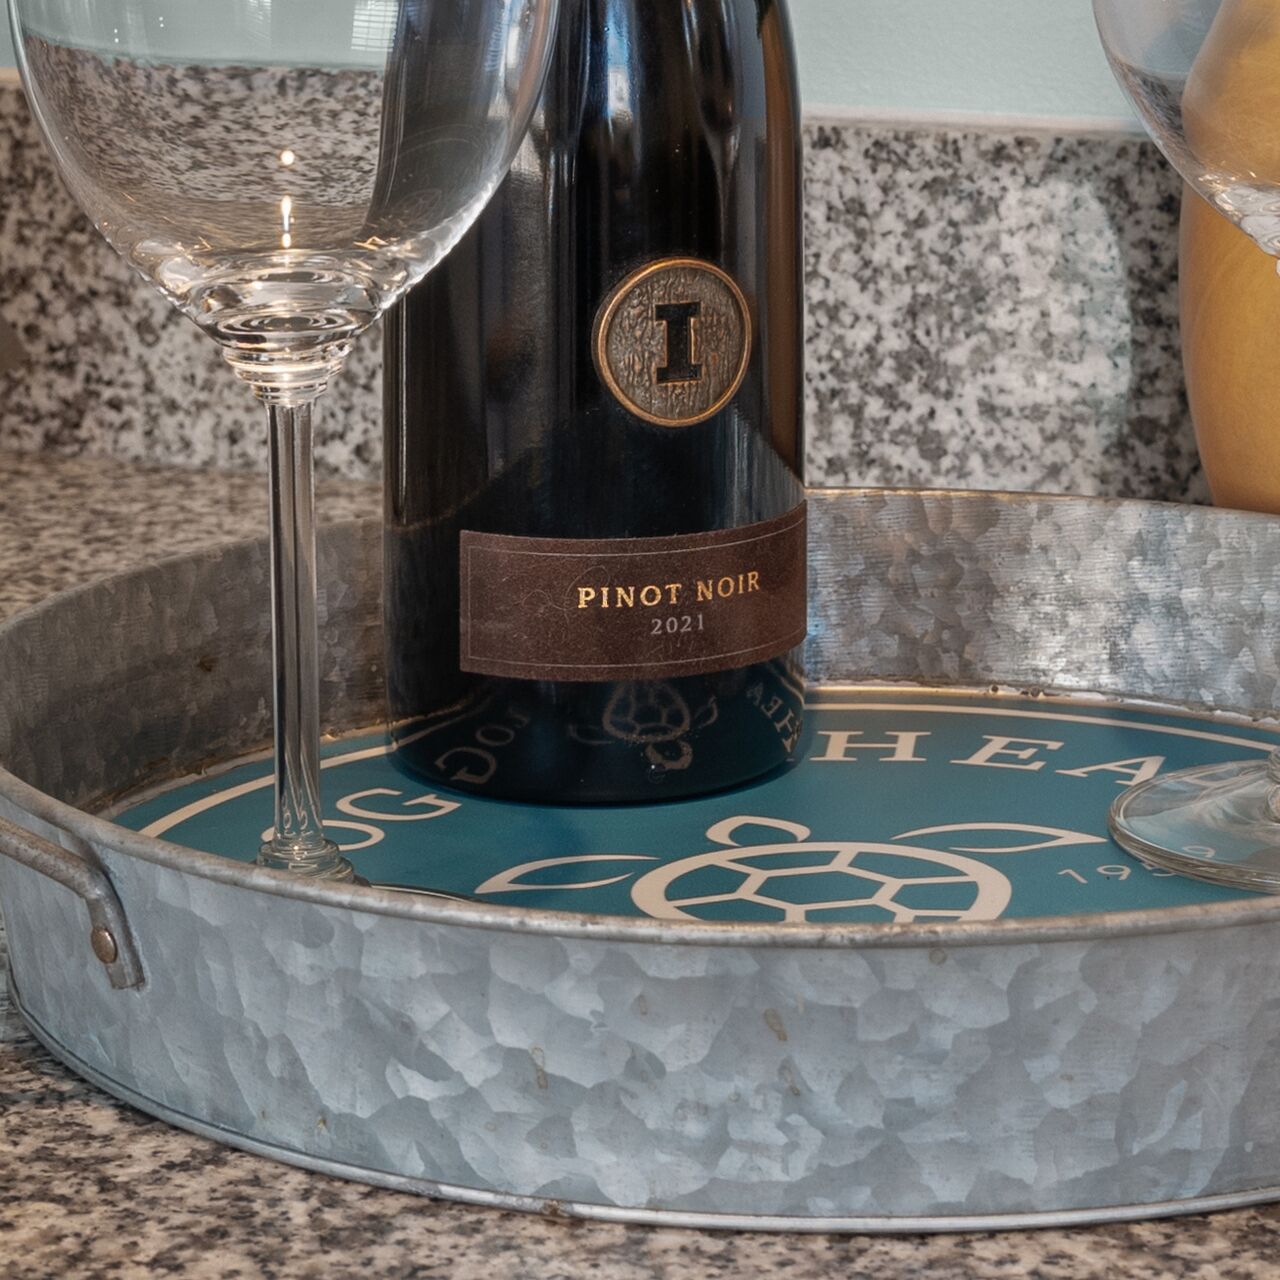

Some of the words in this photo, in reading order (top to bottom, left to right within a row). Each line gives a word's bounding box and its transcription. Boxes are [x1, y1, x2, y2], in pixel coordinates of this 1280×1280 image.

[655, 301, 702, 384] I
[577, 583, 682, 609] PINOT
[696, 570, 761, 602] NOIR
[650, 613, 704, 635] 2021
